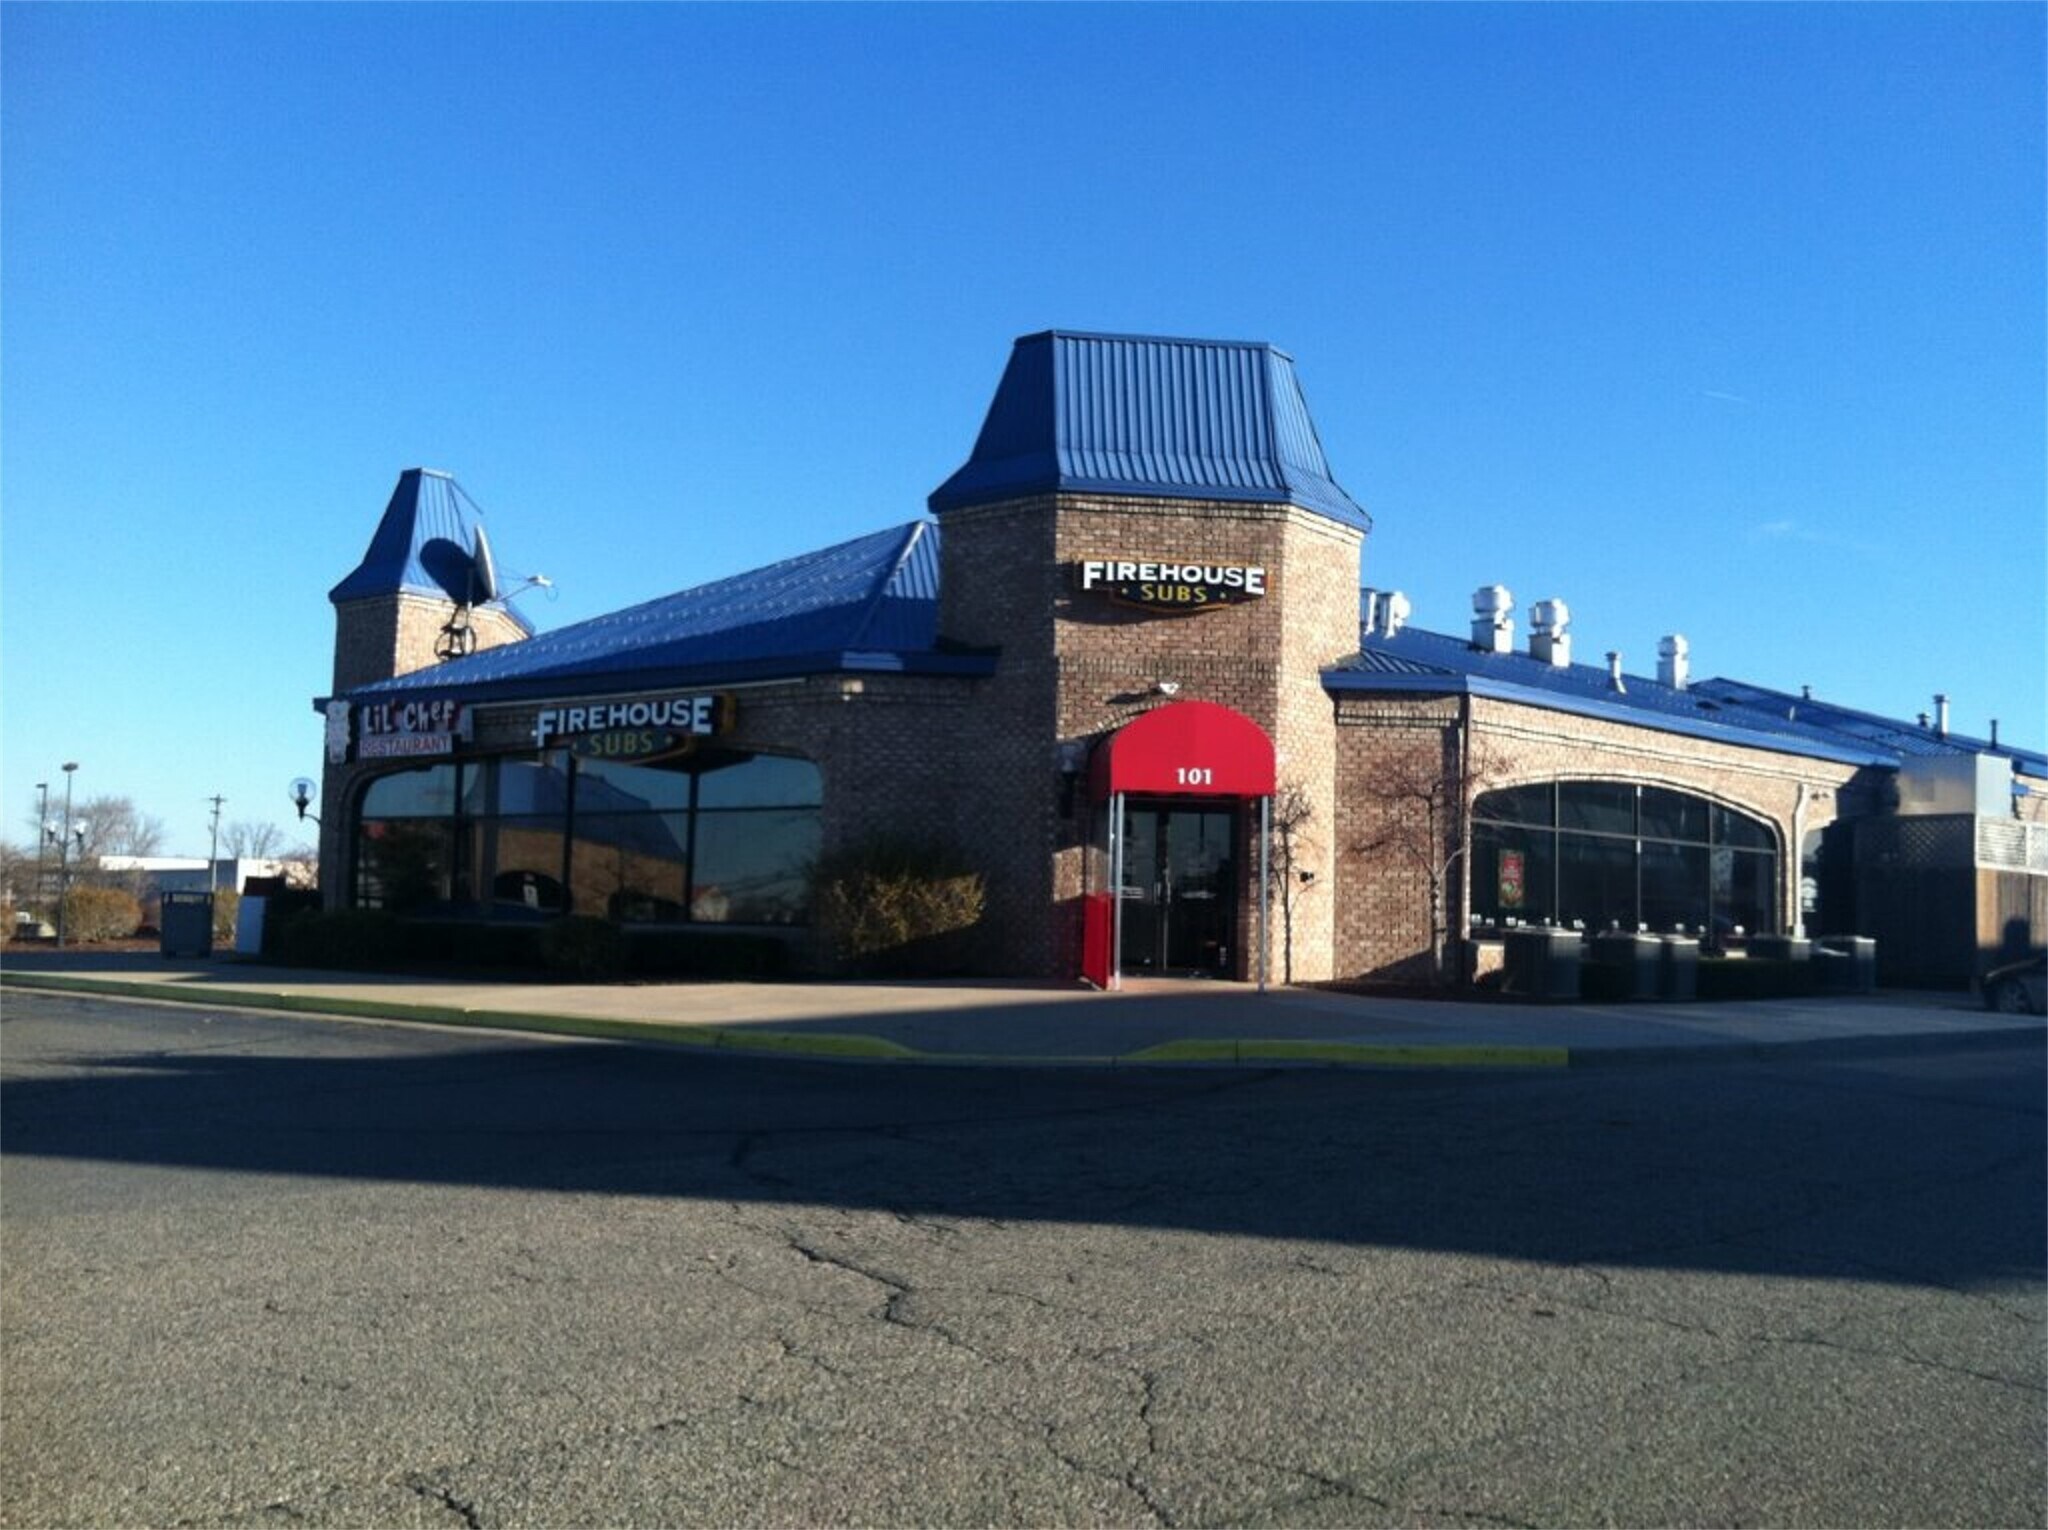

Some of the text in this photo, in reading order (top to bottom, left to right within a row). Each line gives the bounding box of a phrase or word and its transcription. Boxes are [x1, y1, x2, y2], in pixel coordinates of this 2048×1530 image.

[1083, 561, 1265, 595] FIREHOUSE
[1140, 583, 1207, 602] SUBS
[537, 697, 713, 748] FIREHOUSE
[589, 730, 654, 754] SUBS
[1177, 767, 1212, 785] 101
